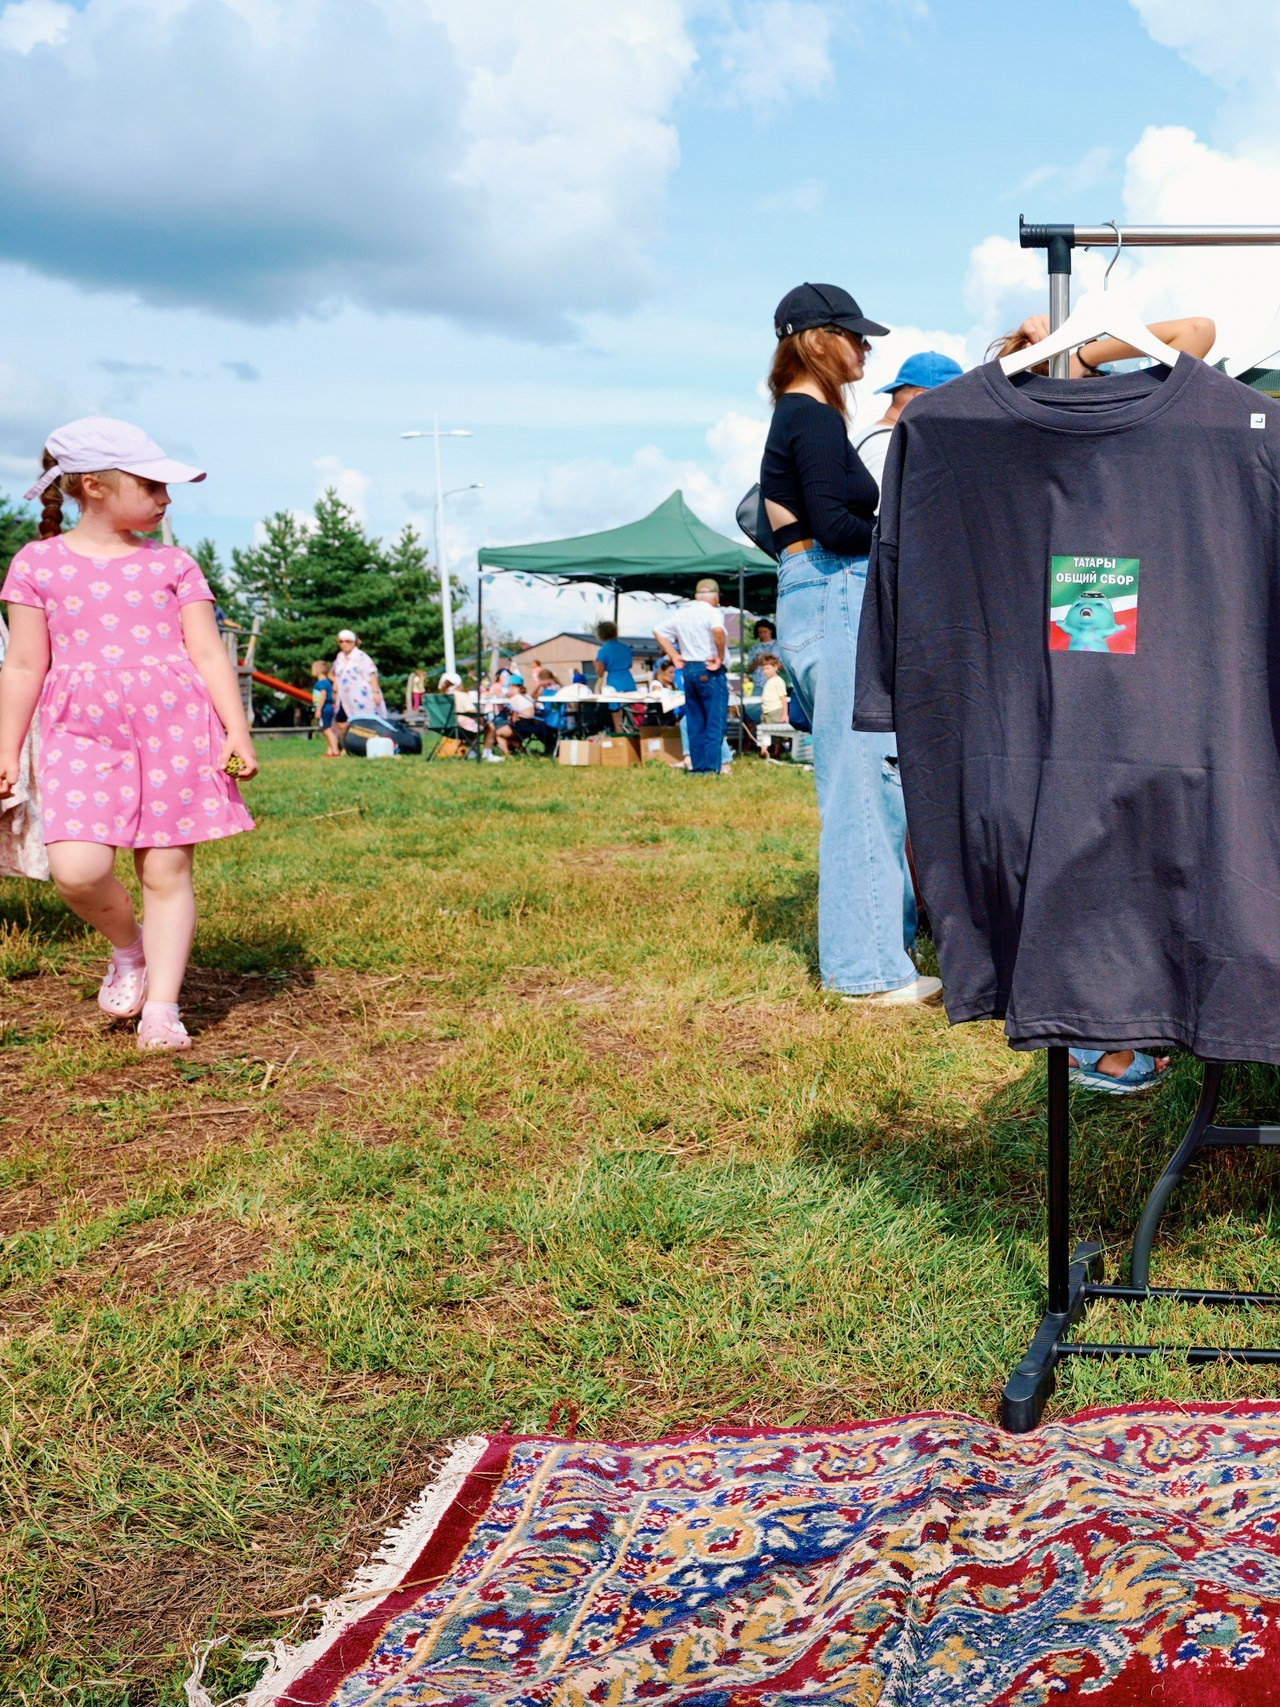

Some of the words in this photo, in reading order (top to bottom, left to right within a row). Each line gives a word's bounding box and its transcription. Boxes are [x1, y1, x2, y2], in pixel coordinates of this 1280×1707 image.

[1073, 557, 1116, 569] ТАТАРЫ
[1055, 571, 1097, 585] ОБЩИЙ
[1100, 573, 1135, 586] СБОР
